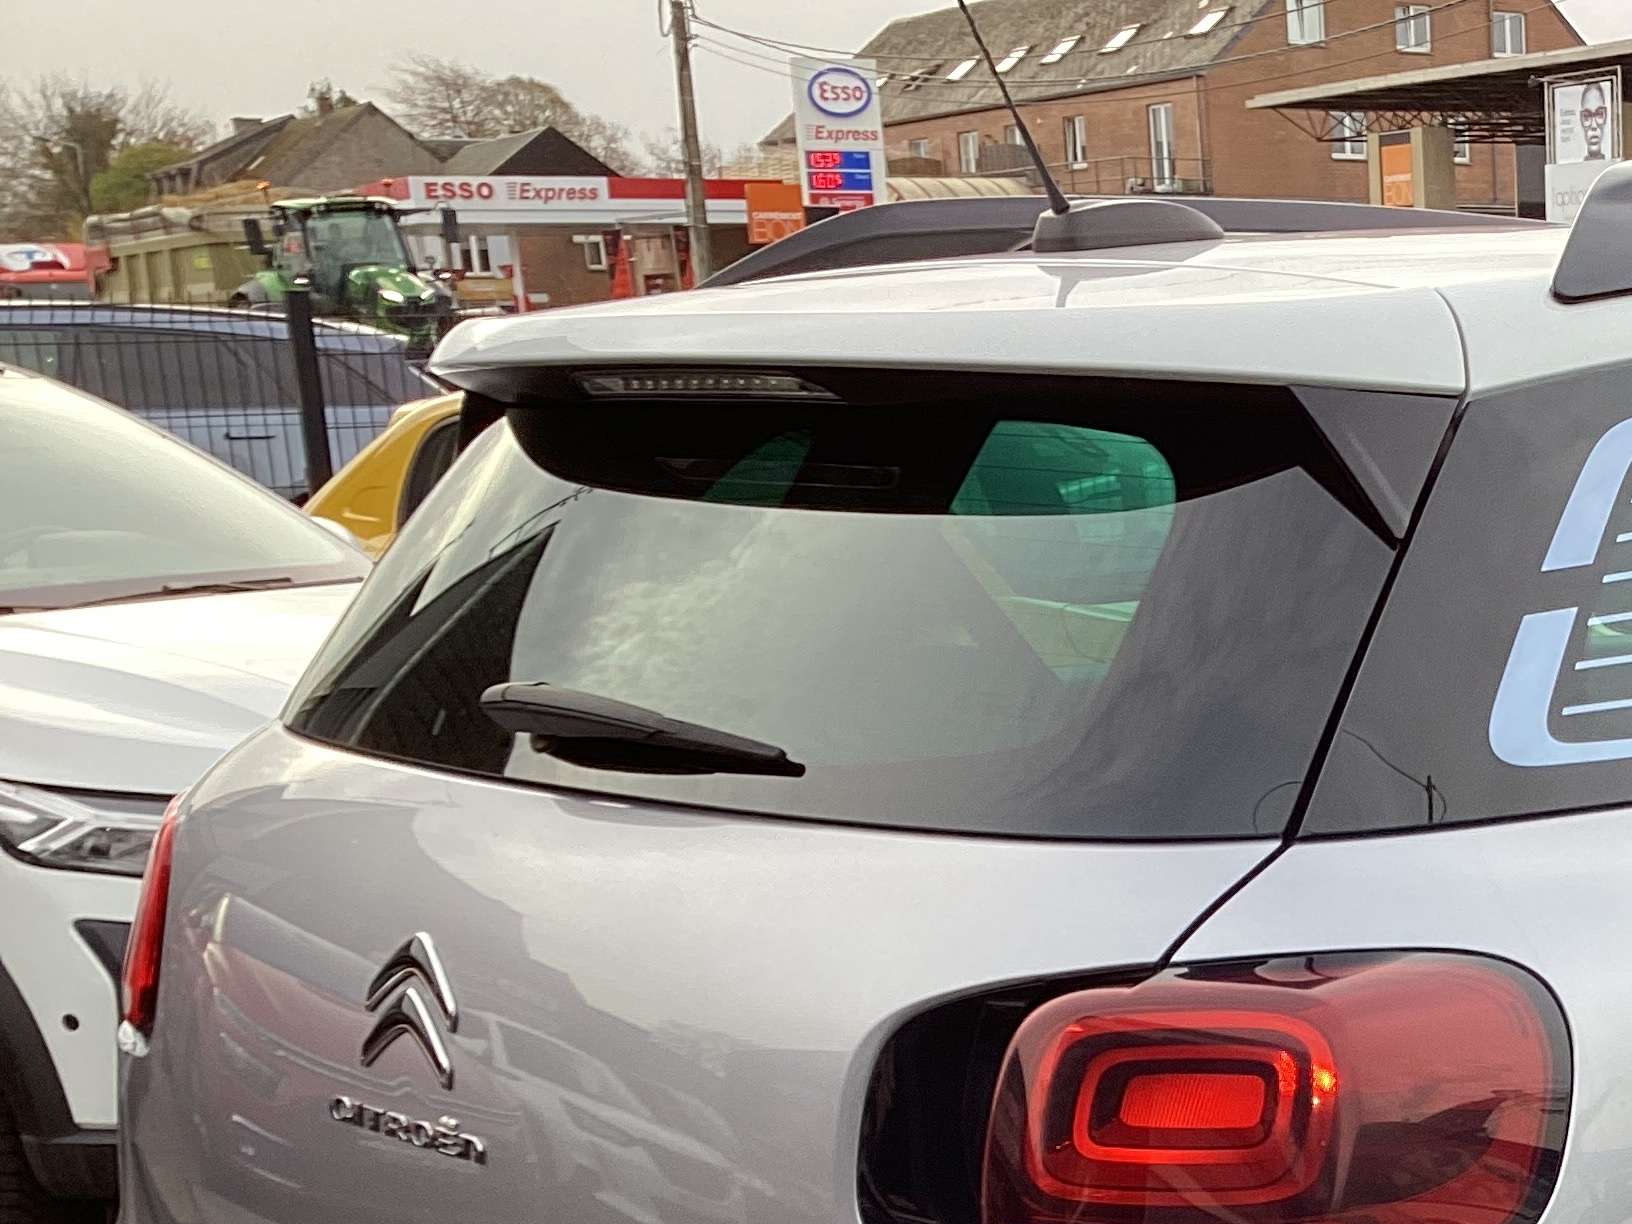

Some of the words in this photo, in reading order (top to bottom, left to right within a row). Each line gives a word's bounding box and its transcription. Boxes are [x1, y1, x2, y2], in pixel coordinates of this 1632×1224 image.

[814, 124, 879, 143] Express
[424, 181, 494, 200] ESSO
[518, 181, 599, 204] Express
